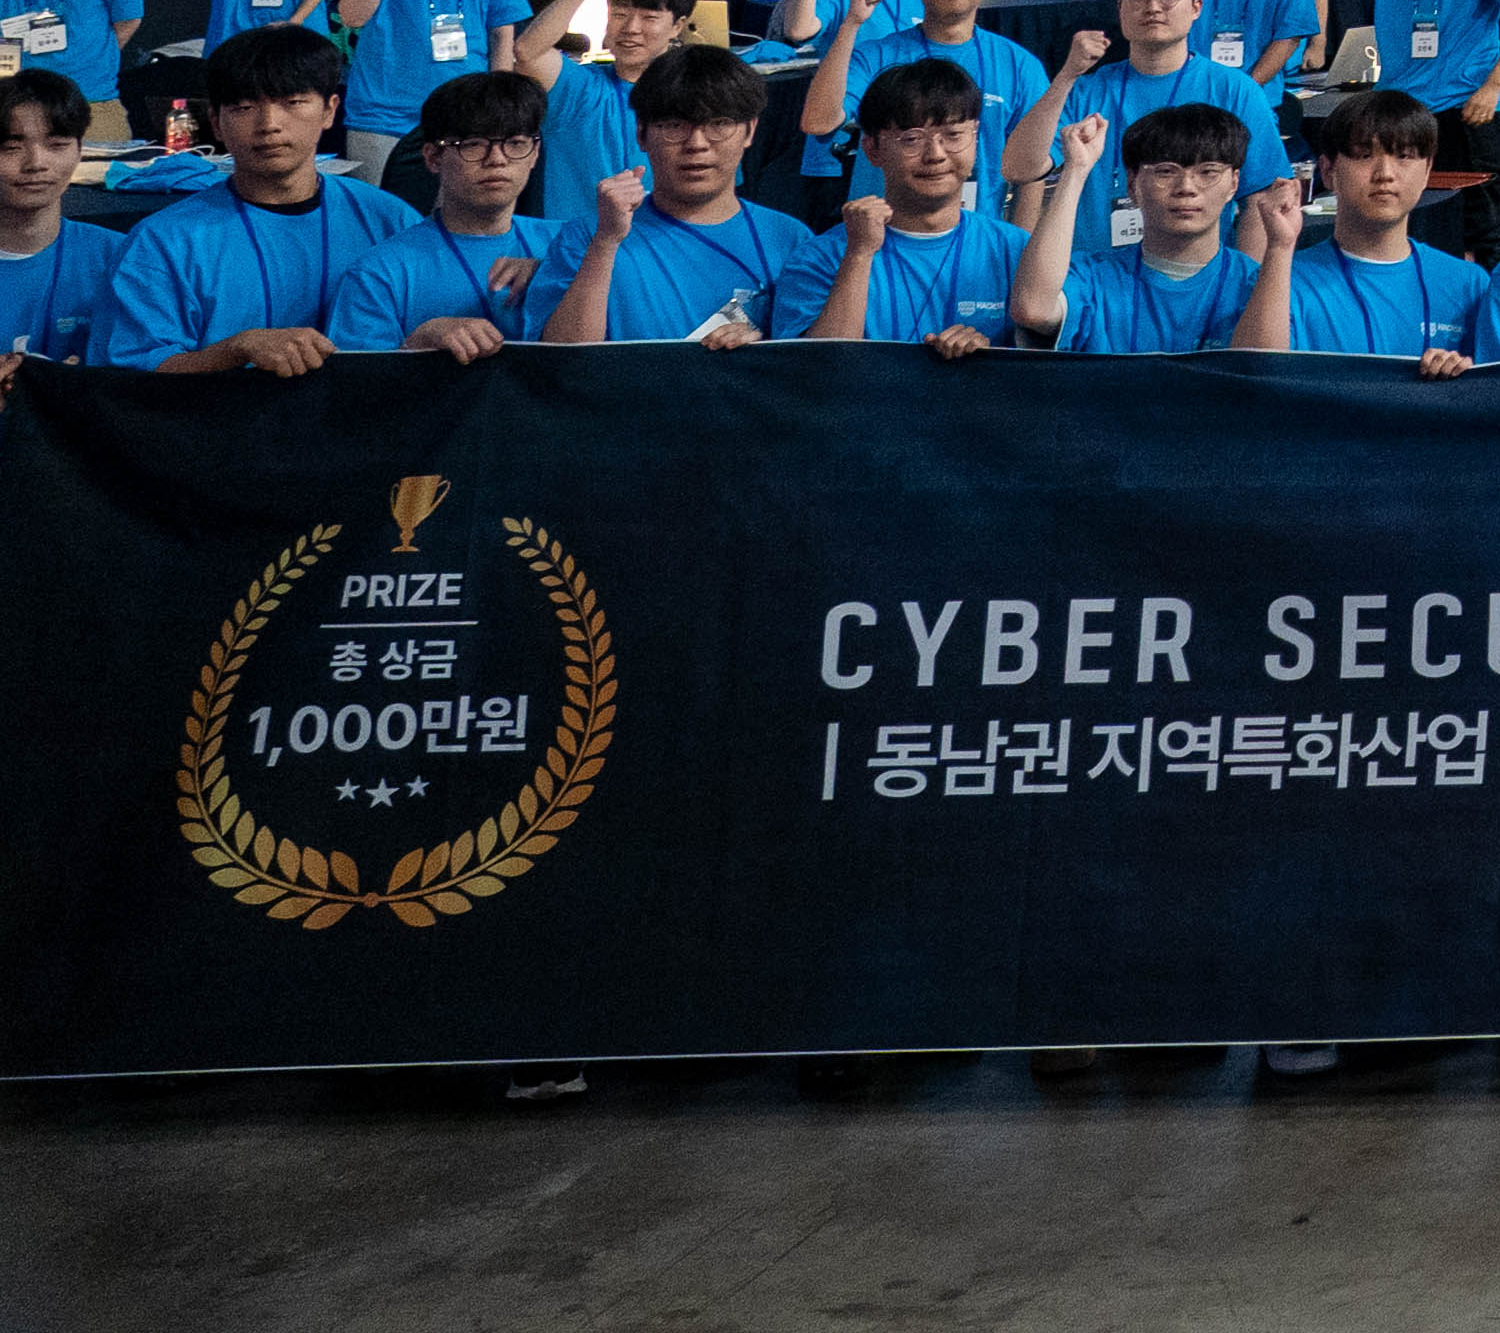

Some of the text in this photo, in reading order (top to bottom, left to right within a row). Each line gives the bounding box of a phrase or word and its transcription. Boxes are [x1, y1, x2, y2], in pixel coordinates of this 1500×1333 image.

[340, 572, 464, 609] PRIZE
[329, 639, 458, 682] 총 상금
[820, 596, 1194, 690] CYBER
[247, 694, 529, 767] 1,000만원
[867, 718, 1069, 798] 동남권
[1088, 709, 1491, 793] 지역특화산업
